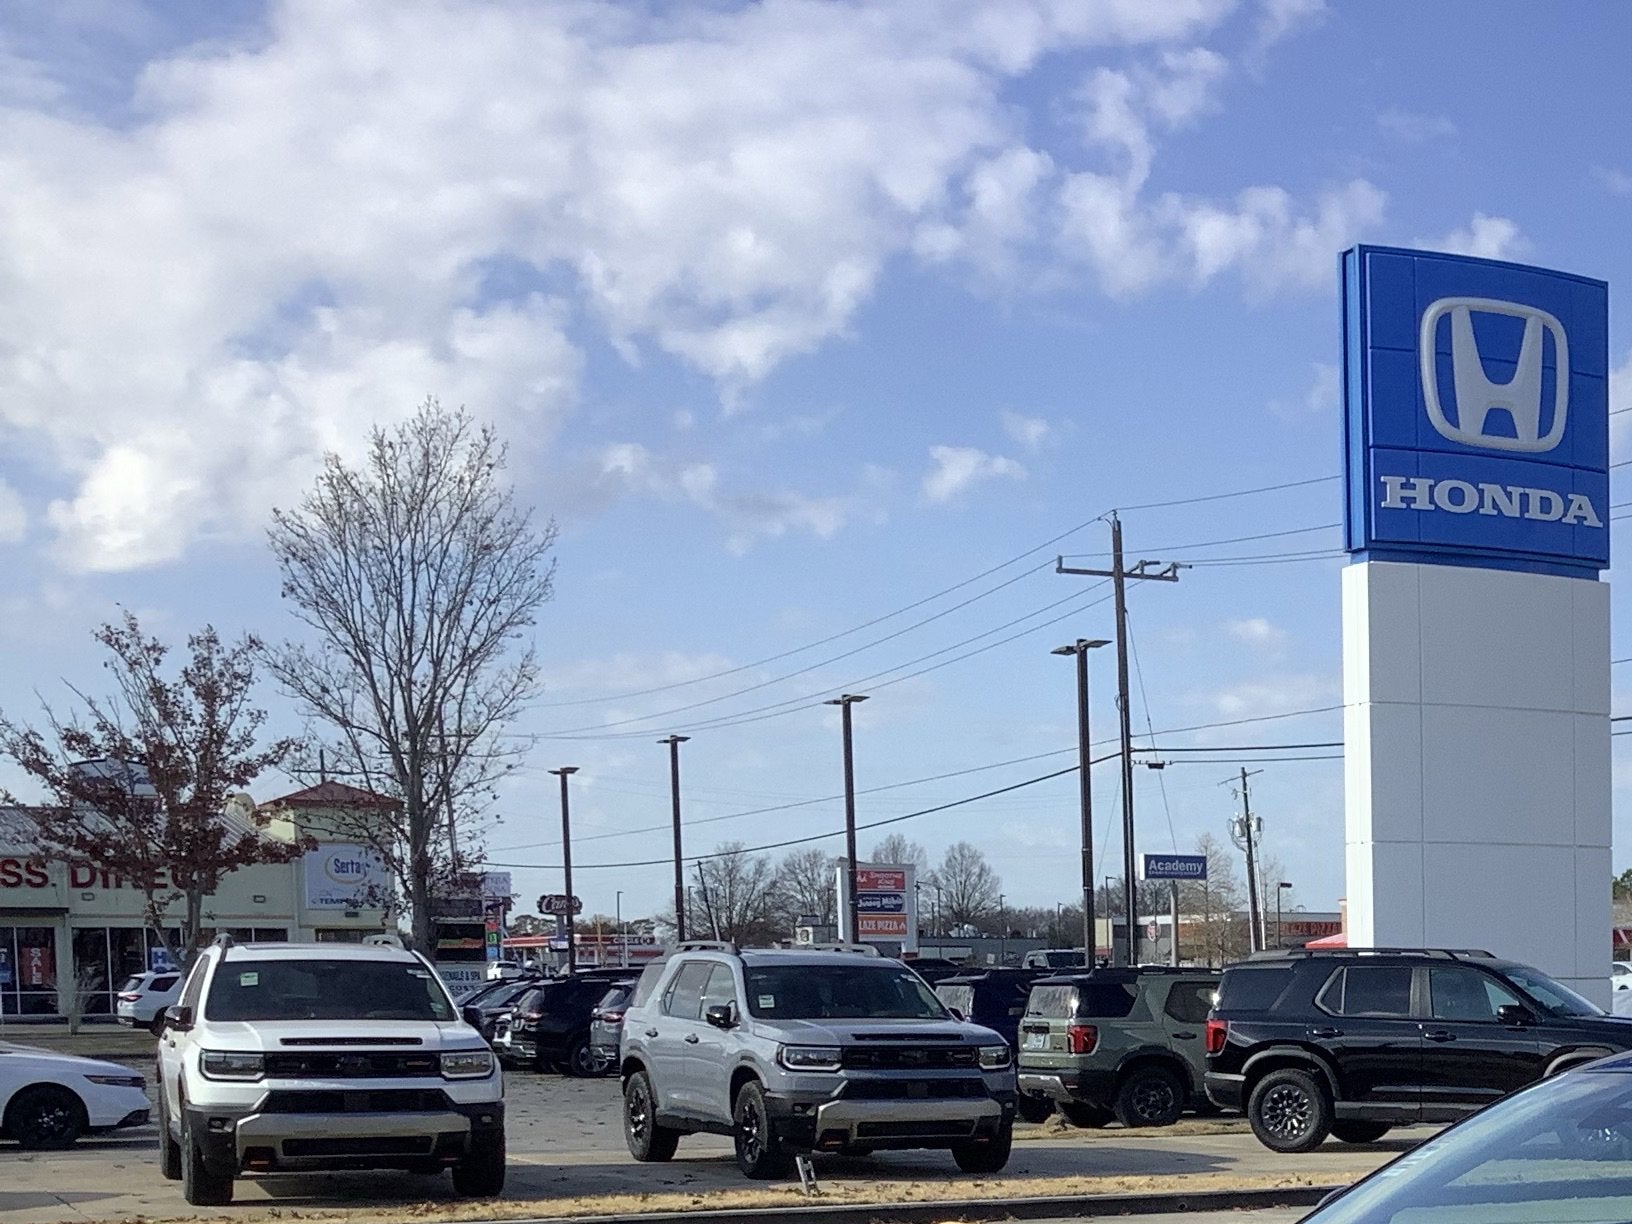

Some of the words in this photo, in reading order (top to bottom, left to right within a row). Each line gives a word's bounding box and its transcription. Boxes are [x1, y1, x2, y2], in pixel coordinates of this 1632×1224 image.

[1380, 475, 1603, 528] HONDA
[333, 858, 361, 874] Serta
[1148, 860, 1203, 874] Academy
[859, 920, 876, 930] LAZE
[877, 920, 898, 930] PIZZA
[30, 948, 42, 984] SALE
